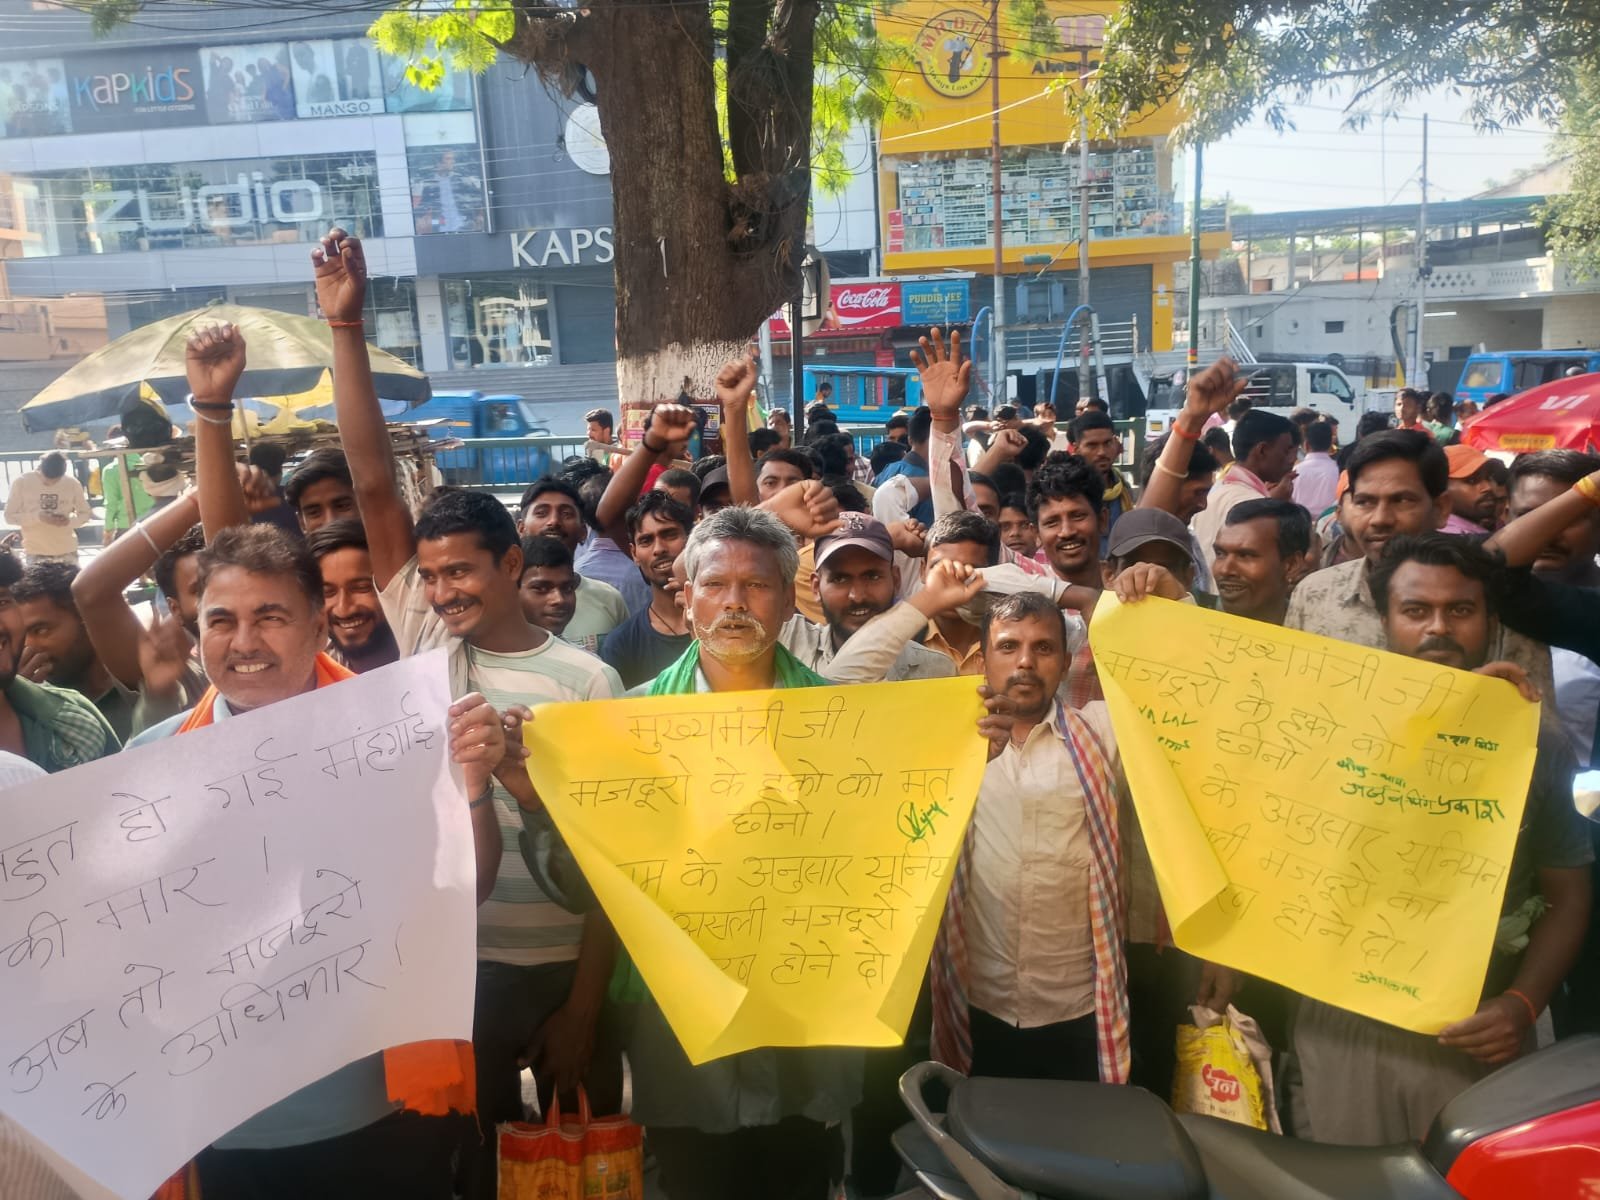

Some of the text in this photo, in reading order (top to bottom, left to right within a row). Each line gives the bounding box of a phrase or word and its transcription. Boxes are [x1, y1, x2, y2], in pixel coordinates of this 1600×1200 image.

[310, 101, 371, 116] MANGO
[627, 694, 784, 755] मुख्यमंत्री
[709, 756, 748, 798] के
[836, 756, 884, 800] को
[899, 767, 955, 799] मत
[1200, 763, 1241, 810] के
[1422, 746, 1486, 785] मत
[112, 791, 172, 843] हो
[84, 858, 228, 931] मार
[681, 848, 723, 896] के
[769, 939, 841, 986] होने
[8, 1008, 96, 1094] अब
[117, 963, 176, 1029] तो
[81, 1071, 137, 1122] के
